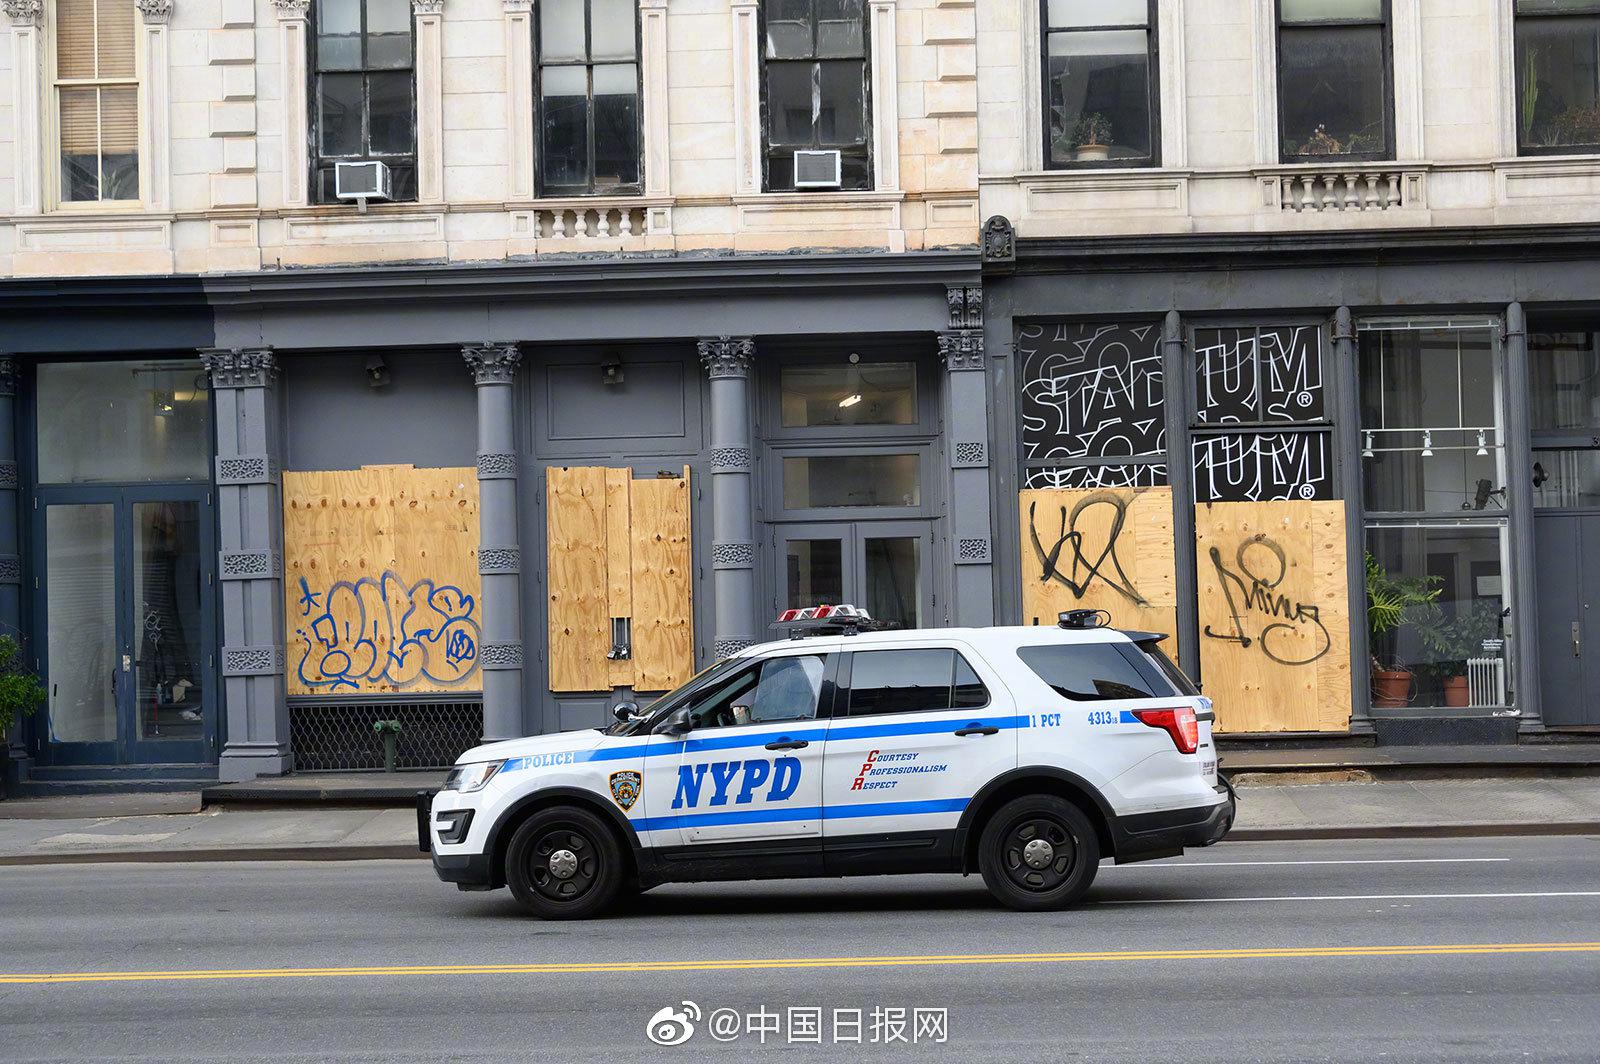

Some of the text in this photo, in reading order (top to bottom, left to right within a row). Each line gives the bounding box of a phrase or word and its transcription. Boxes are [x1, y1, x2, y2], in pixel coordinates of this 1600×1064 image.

[1032, 713, 1061, 728] 1 PCT
[1088, 711, 1112, 725] 4313
[523, 752, 573, 770] POLICE
[867, 750, 919, 763] COURTESY
[859, 763, 947, 776] PROFESSIONALISM
[671, 757, 802, 809] NYPD
[850, 777, 898, 791] RESPECT
